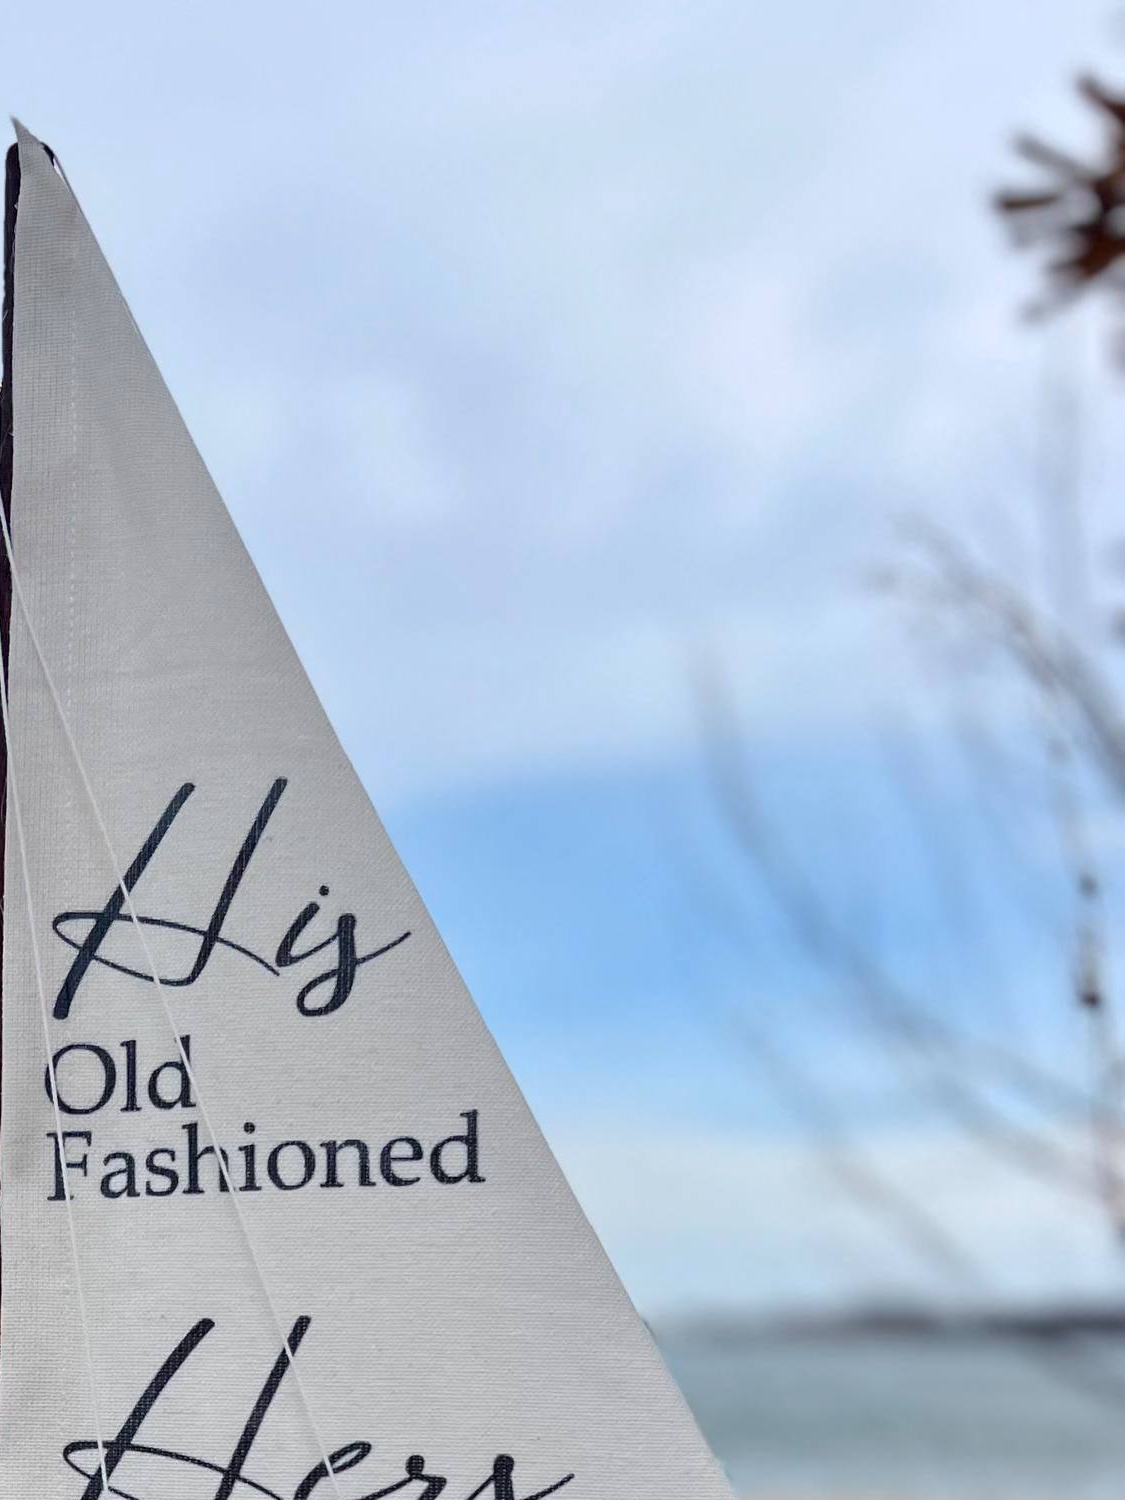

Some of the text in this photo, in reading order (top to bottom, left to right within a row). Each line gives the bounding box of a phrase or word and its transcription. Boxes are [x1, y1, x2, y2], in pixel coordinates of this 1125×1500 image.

[51, 776, 412, 1021] His
[43, 1034, 197, 1116] Old
[45, 1108, 487, 1202] Fashioned
